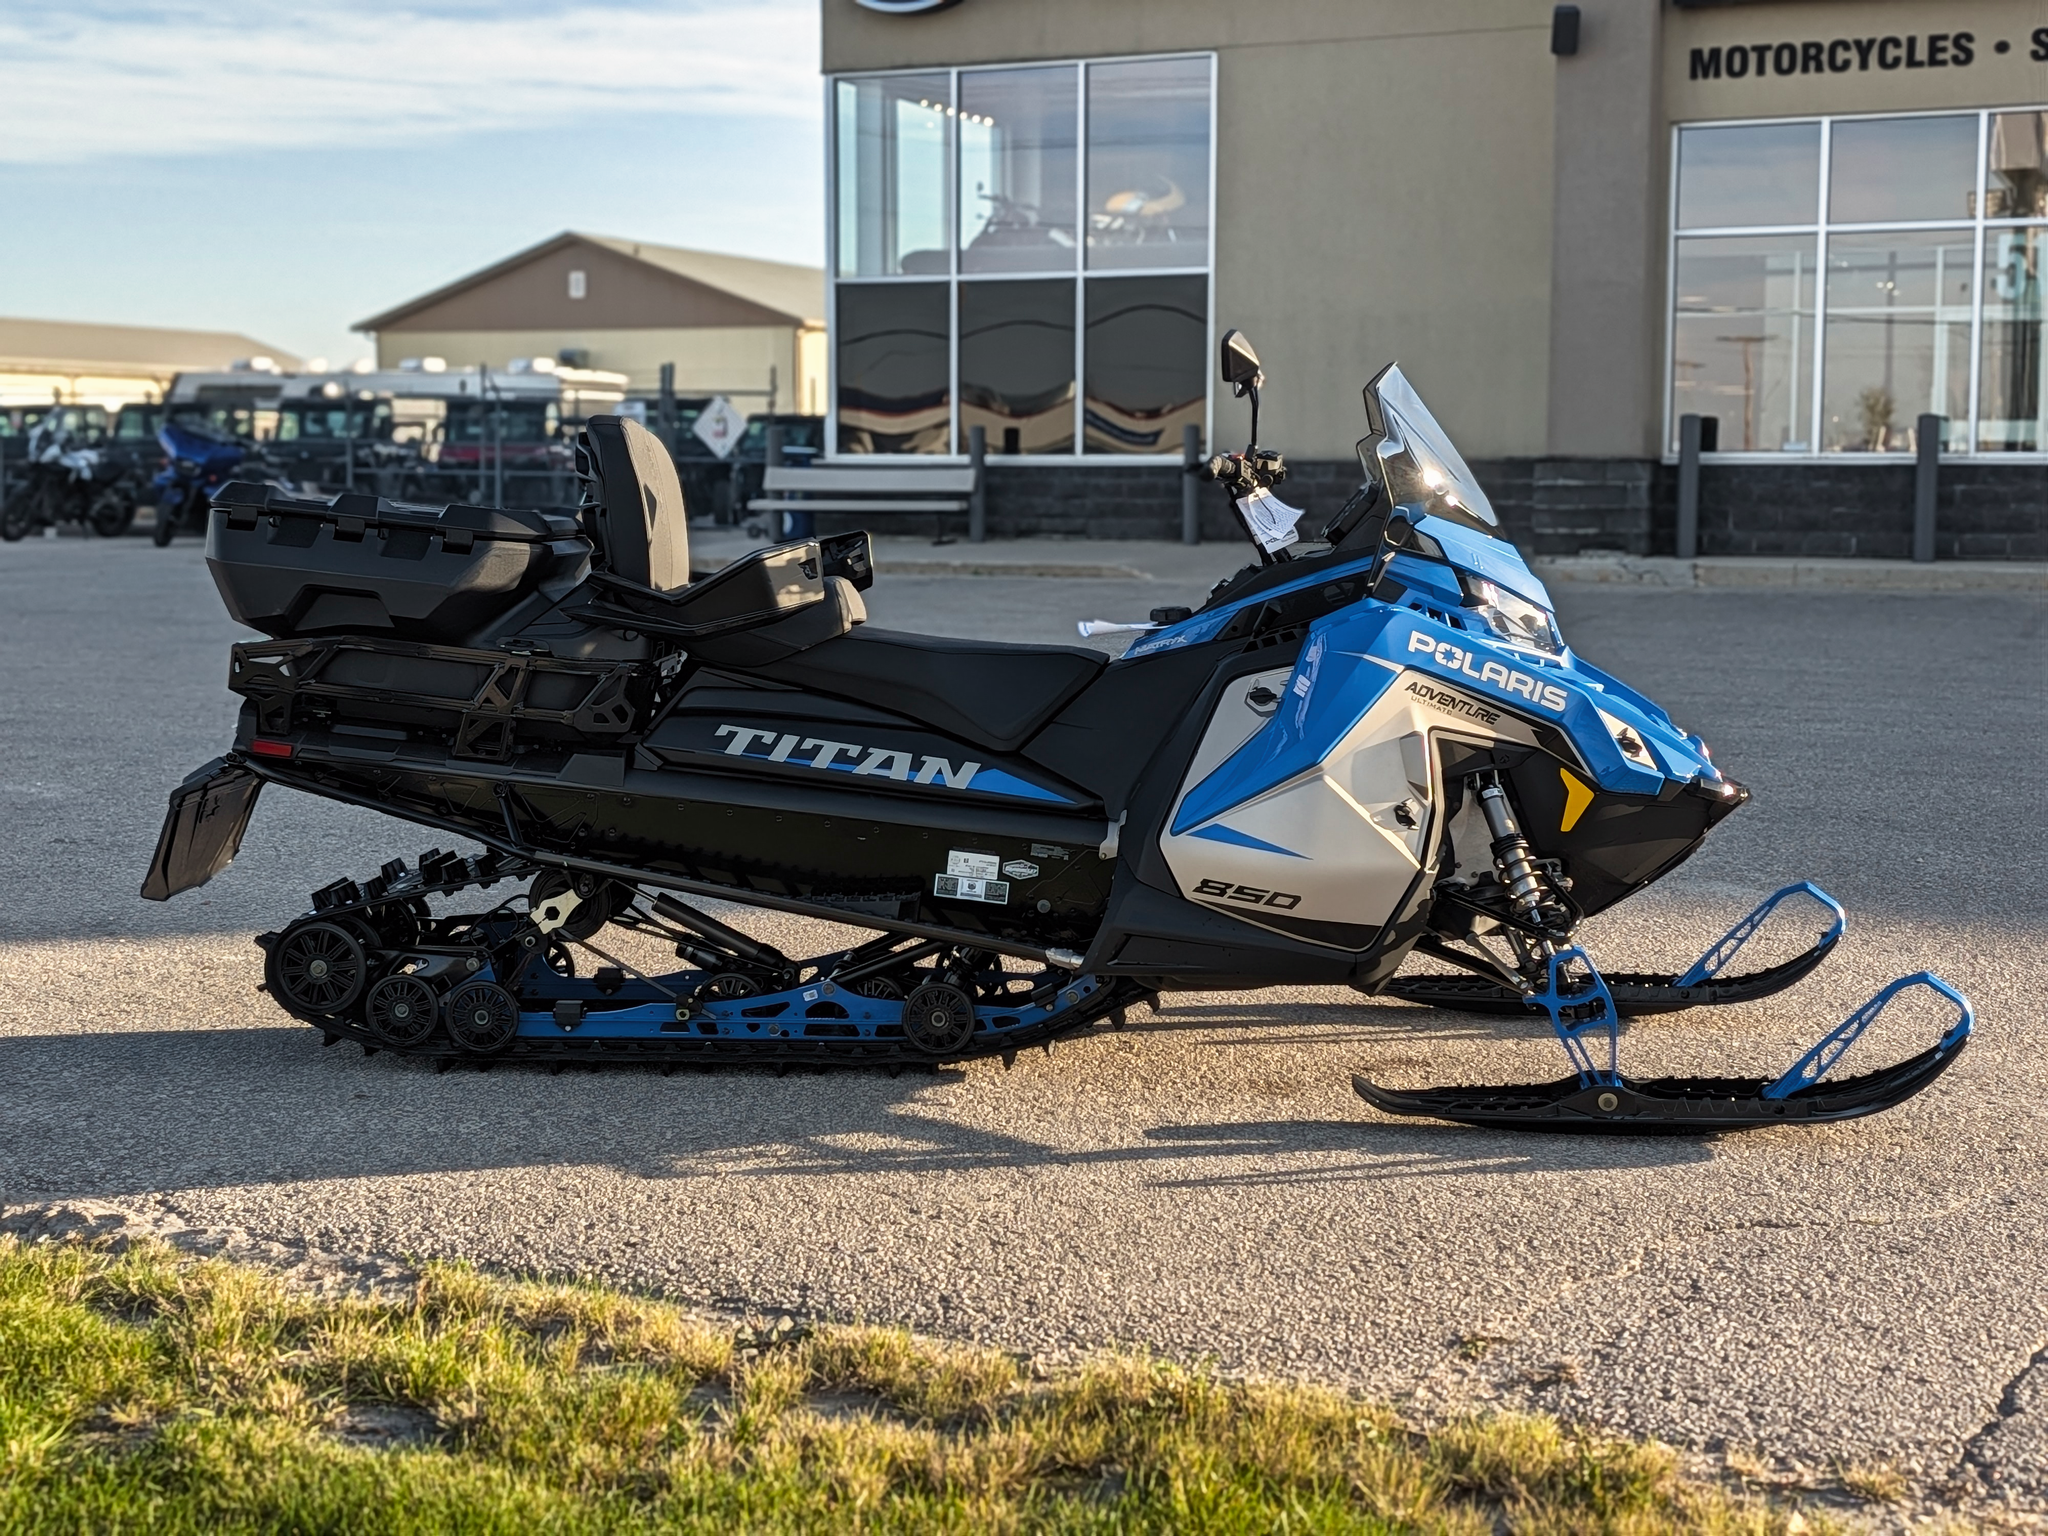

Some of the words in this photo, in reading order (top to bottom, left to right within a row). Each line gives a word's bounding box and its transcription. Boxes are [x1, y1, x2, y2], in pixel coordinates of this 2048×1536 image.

[1689, 32, 1975, 81] MOTORCYCLES
[1408, 630, 1568, 712] POLARIS
[1404, 681, 1501, 725] ADVENTURE
[1411, 695, 1453, 716] ULTIMATE
[714, 724, 982, 790] TITAN
[1192, 878, 1302, 910] 850
